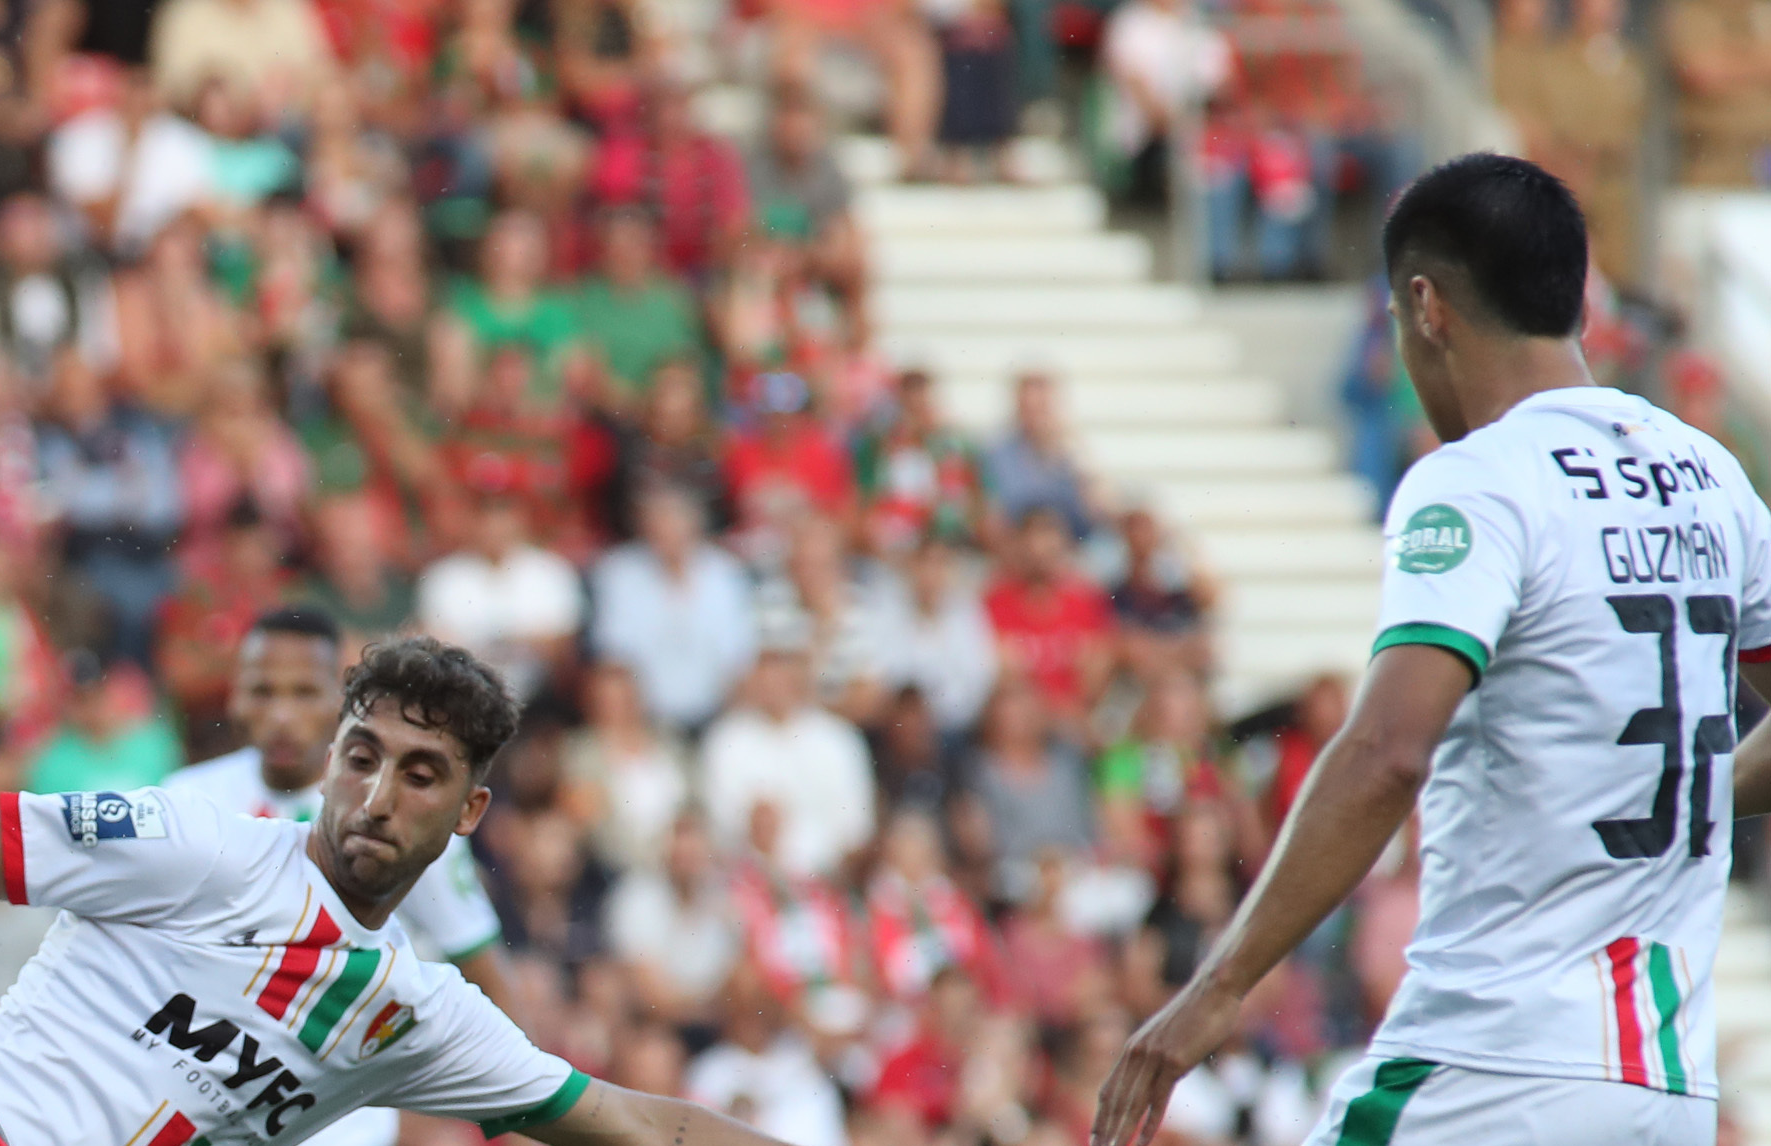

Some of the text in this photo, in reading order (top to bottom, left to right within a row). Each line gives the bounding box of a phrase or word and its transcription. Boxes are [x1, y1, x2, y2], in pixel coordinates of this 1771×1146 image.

[1601, 502, 1730, 584] GUZMÁN
[130, 1027, 161, 1051] MY
[144, 992, 317, 1137] MYFC
